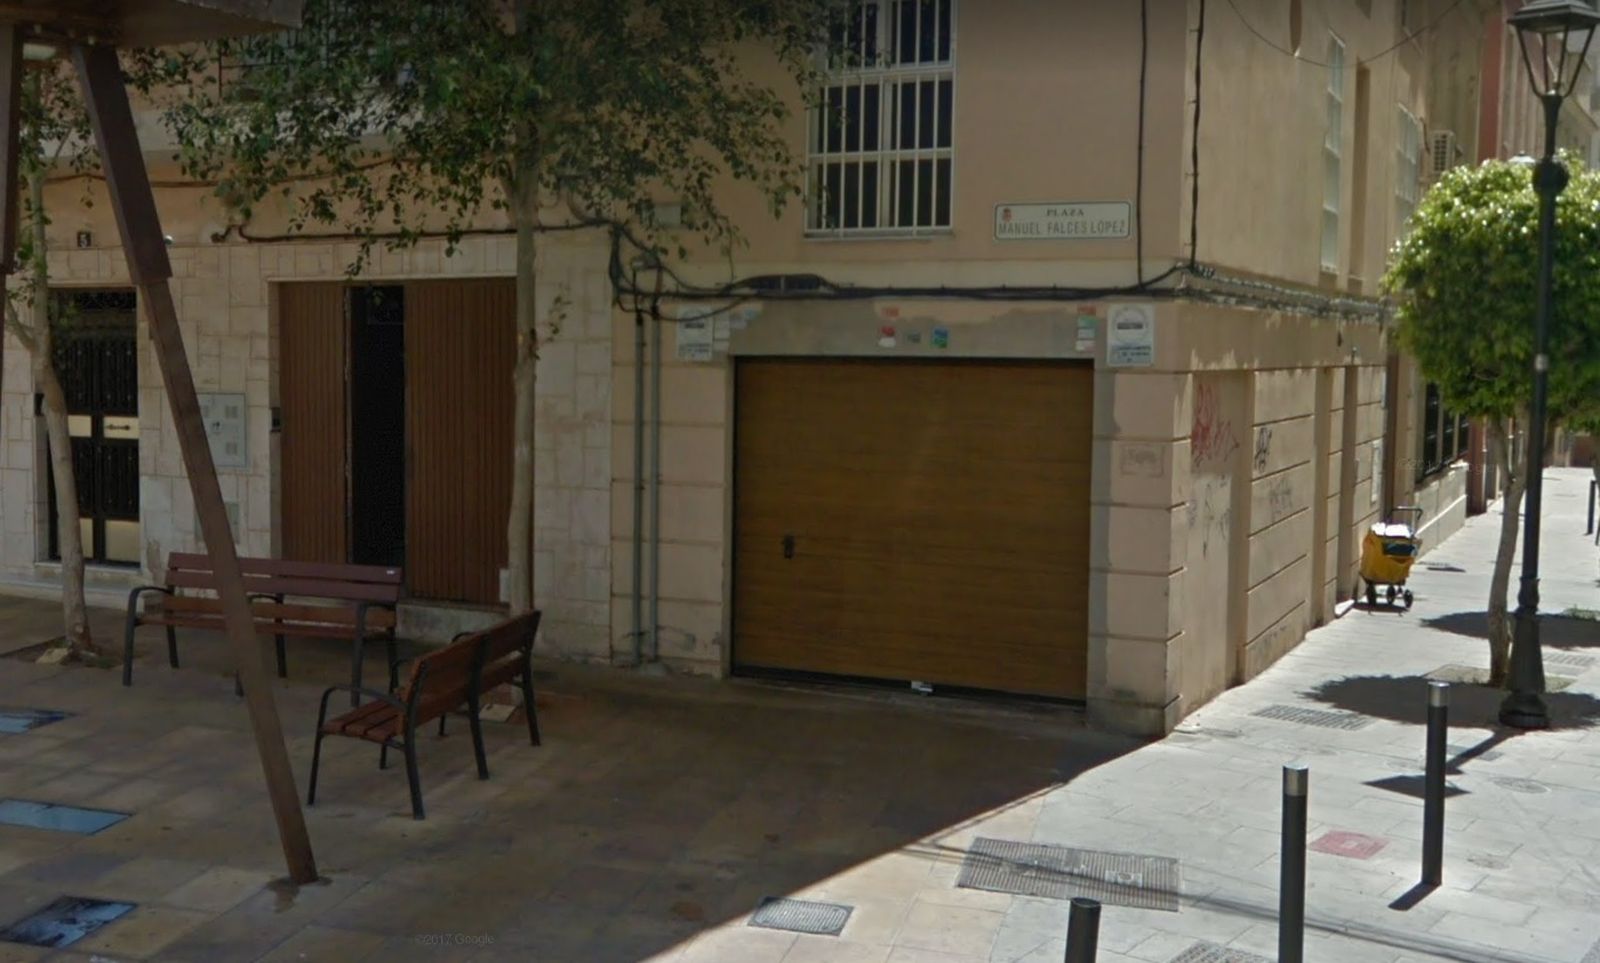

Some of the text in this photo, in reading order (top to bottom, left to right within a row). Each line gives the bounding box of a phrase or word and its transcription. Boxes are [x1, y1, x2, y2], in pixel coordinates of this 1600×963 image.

[1046, 208, 1085, 217] PLAZA
[998, 221, 1041, 235] MANUEL
[1047, 221, 1088, 234] FALCES
